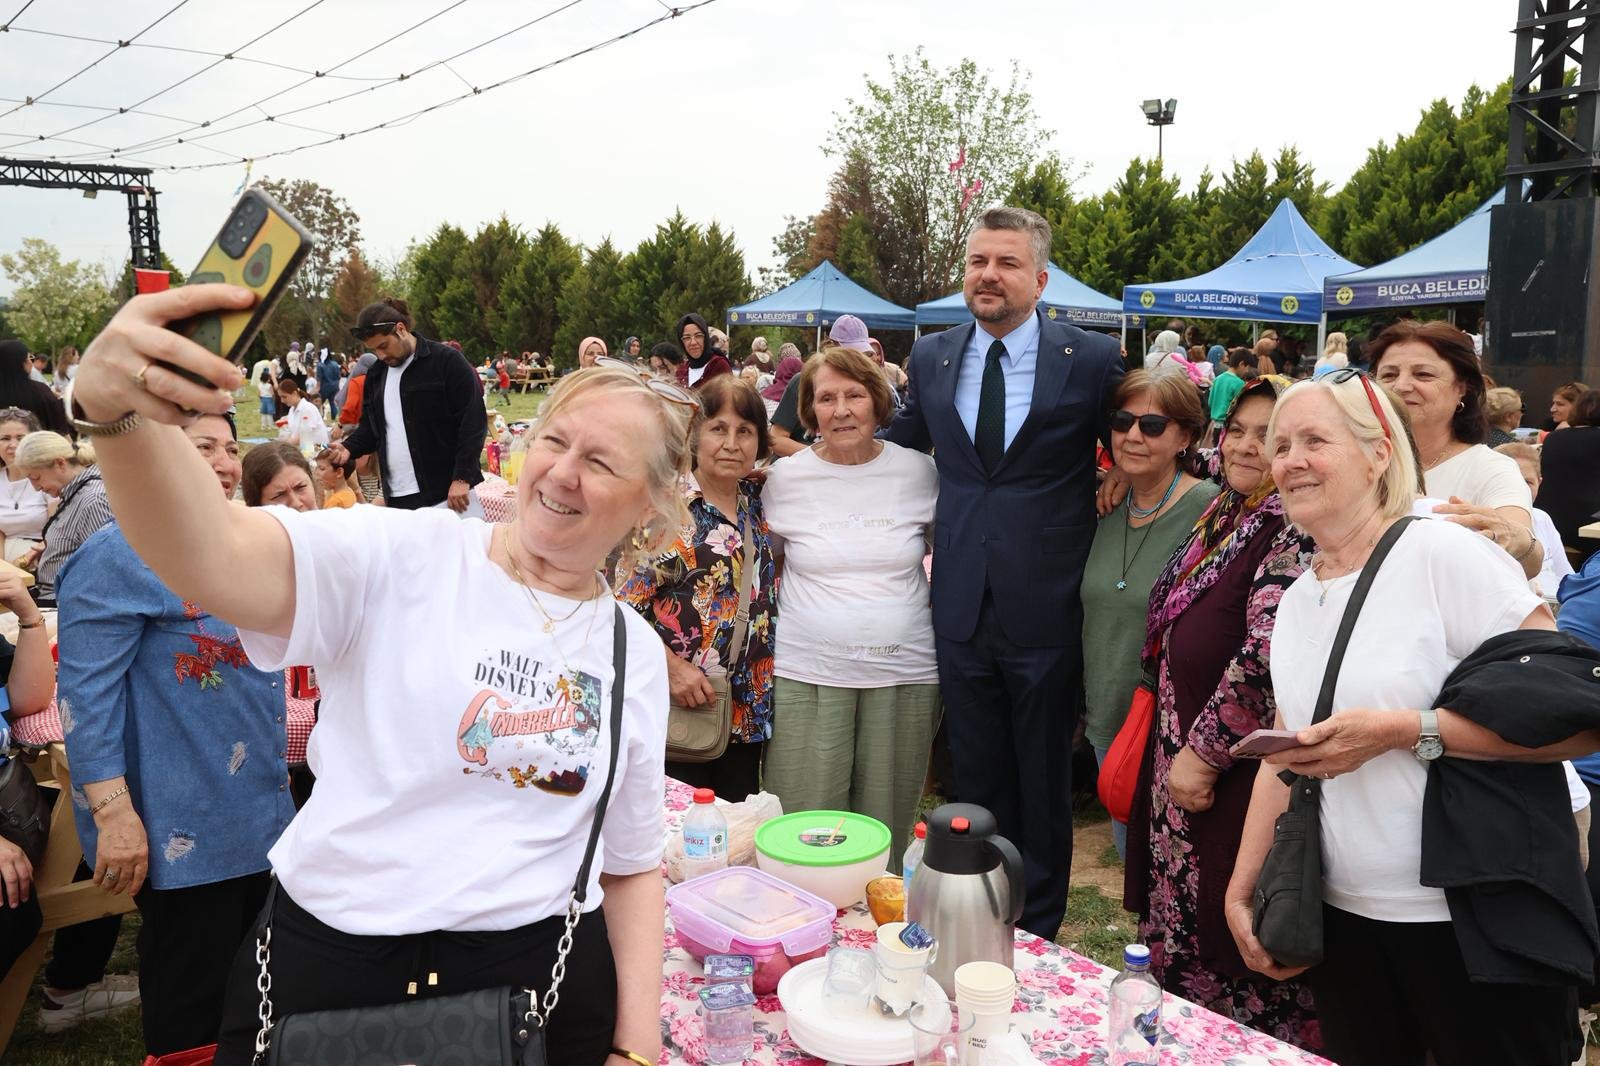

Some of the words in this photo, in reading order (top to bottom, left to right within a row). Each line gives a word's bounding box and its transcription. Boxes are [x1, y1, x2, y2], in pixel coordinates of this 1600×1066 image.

[1378, 283, 1421, 297] BUCA
[1425, 276, 1486, 293] BELEDİ
[1174, 293, 1201, 303] BUCA
[1202, 293, 1259, 306] BELEDİYESİ
[1066, 310, 1086, 318] BUCA
[1087, 311, 1122, 321] BELEDİYES
[500, 649, 543, 678] WALT
[474, 662, 555, 703] DISNEY'S
